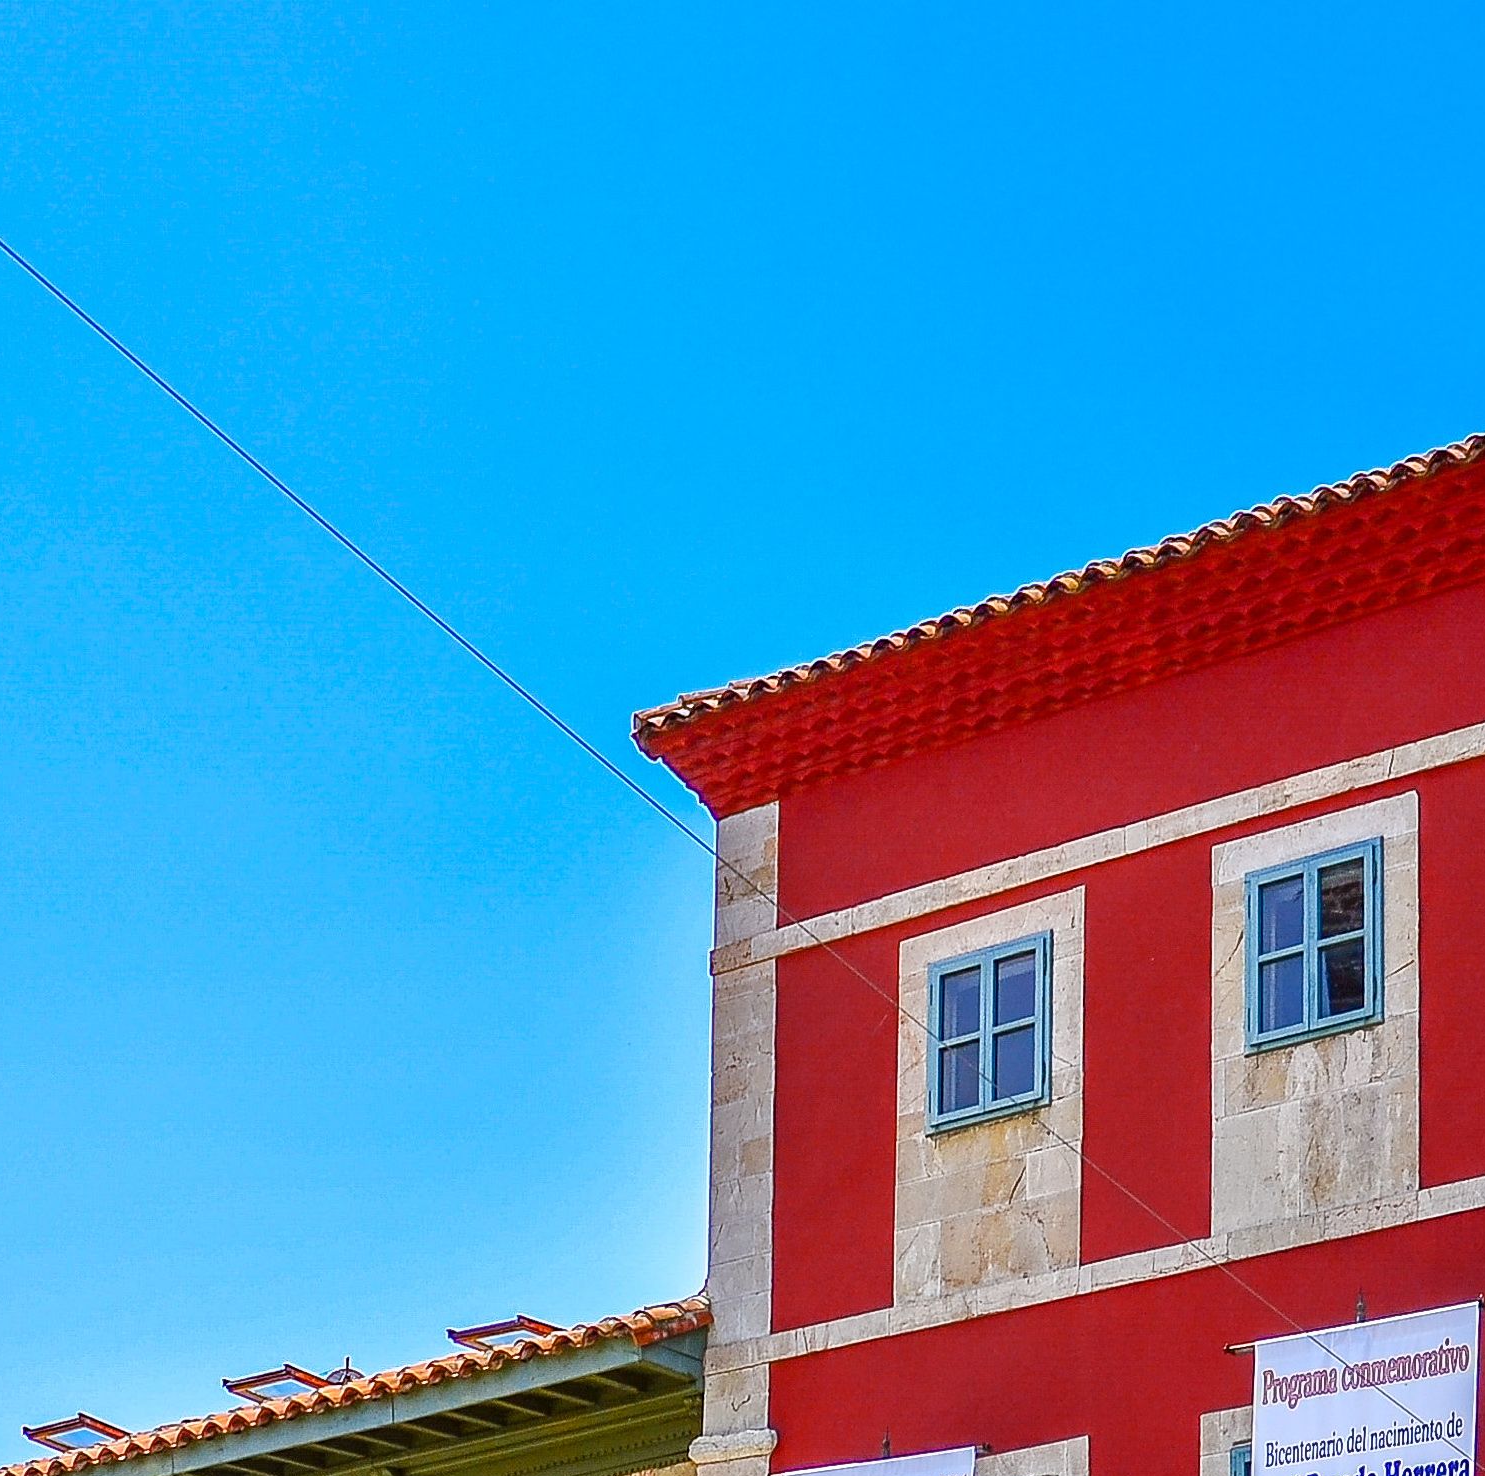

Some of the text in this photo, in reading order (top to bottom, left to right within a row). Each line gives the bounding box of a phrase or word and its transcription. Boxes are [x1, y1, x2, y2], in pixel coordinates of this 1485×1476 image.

[1262, 1338, 1470, 1409] Programa conmemorativo
[1265, 1412, 1462, 1468] Bicentenario del nacimiento de
